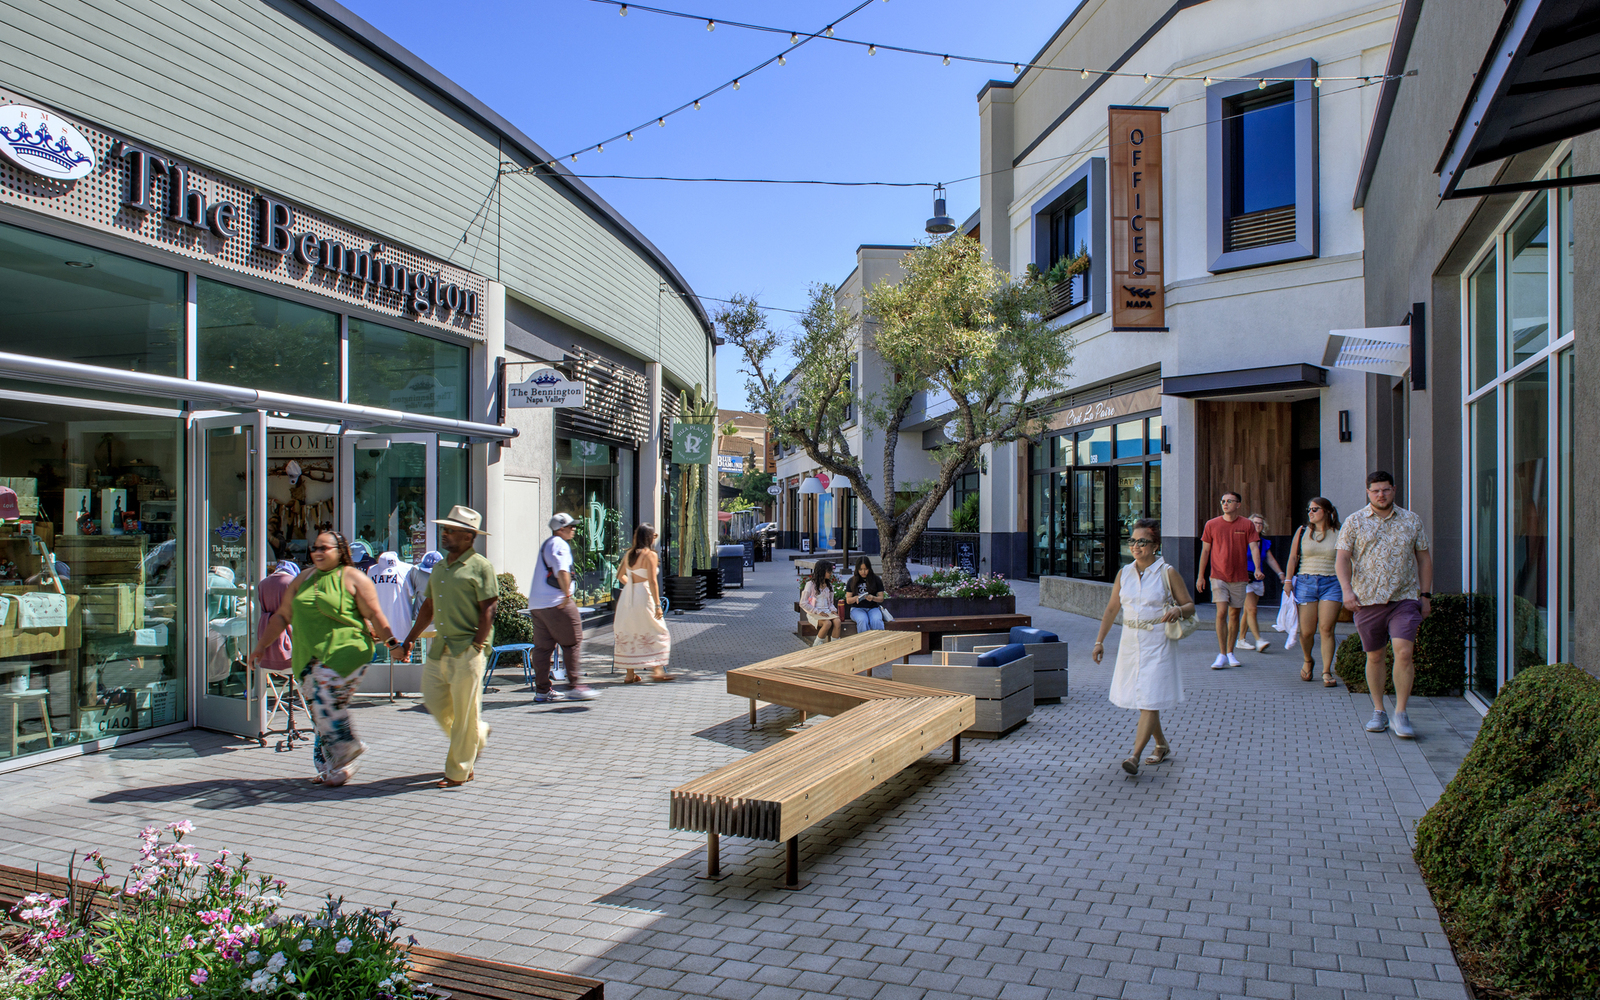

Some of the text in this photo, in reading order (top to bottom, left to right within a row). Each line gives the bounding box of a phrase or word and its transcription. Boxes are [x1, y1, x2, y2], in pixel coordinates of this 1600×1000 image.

[1129, 128, 1146, 277] OFFICES
[112, 142, 480, 318] The Bennington
[1126, 300, 1153, 309] NAPA
[510, 387, 582, 397] The Bennington
[526, 395, 566, 405] Napa Valley
[1082, 404, 1094, 422] La
[689, 425, 709, 438] PLANTS
[273, 435, 335, 449] HOME
[211, 544, 222, 552] The
[98, 716, 130, 732] CIAO
